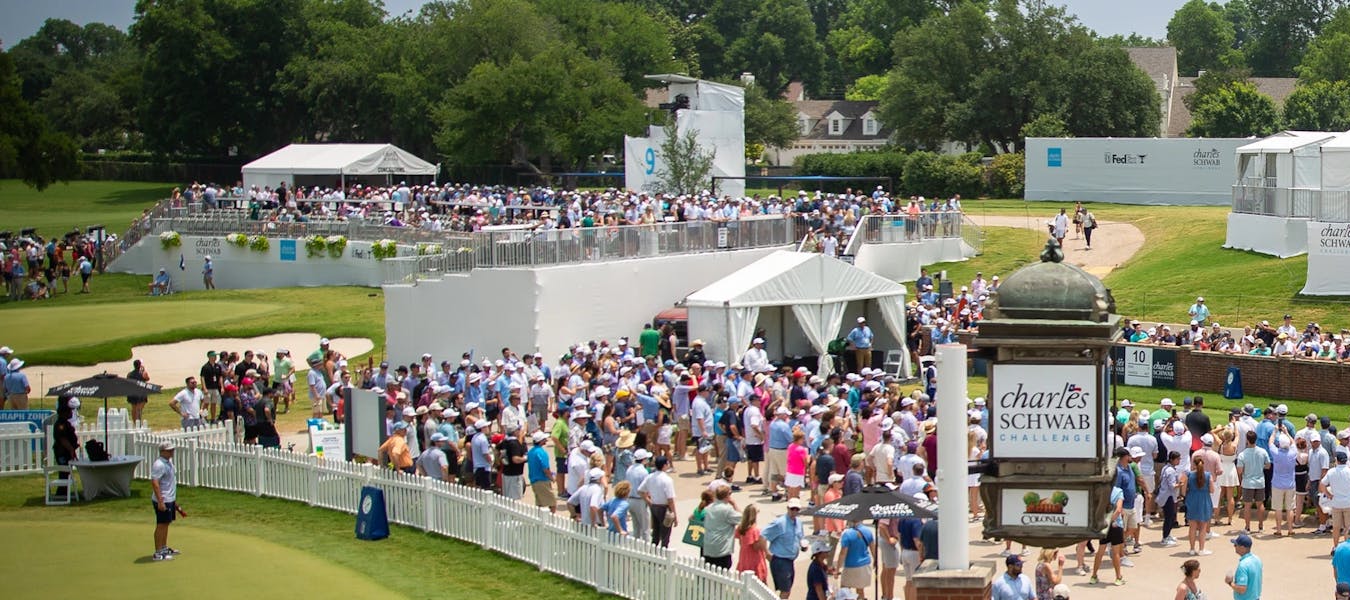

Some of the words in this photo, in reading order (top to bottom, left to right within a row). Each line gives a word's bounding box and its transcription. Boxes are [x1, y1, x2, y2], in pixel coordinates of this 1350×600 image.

[645, 148, 655, 175] 9
[1133, 350, 1146, 363] 10
[1001, 382, 1089, 408] charles
[1000, 413, 1090, 430] SCHWAB
[1021, 515, 1068, 526] COLONIAL
